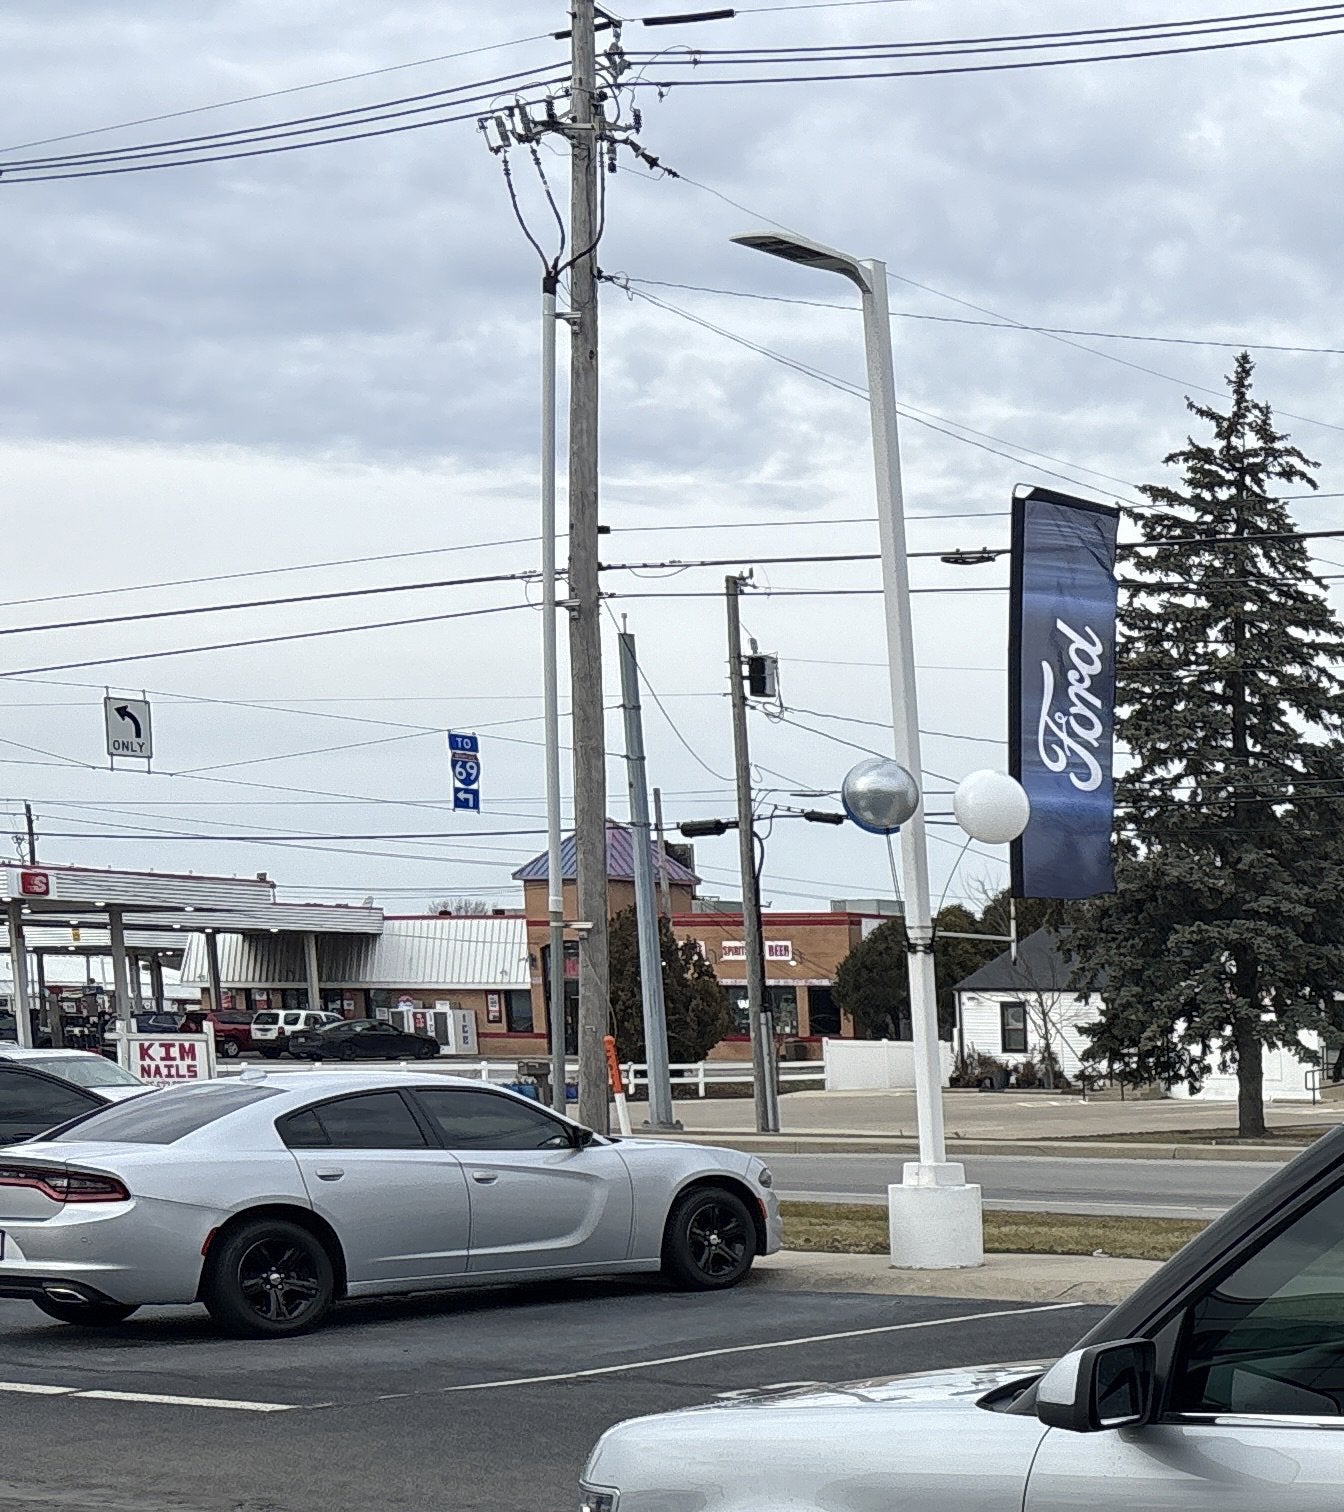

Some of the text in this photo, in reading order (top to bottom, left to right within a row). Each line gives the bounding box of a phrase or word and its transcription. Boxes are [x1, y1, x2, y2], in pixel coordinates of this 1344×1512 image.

[1038, 618, 1104, 791] Ford
[112, 739, 146, 753] ONLY
[455, 737, 472, 749] TO
[455, 761, 478, 781] 69
[768, 945, 790, 957] BEER
[139, 1042, 197, 1062] KIM
[140, 1064, 198, 1079] NAILS
